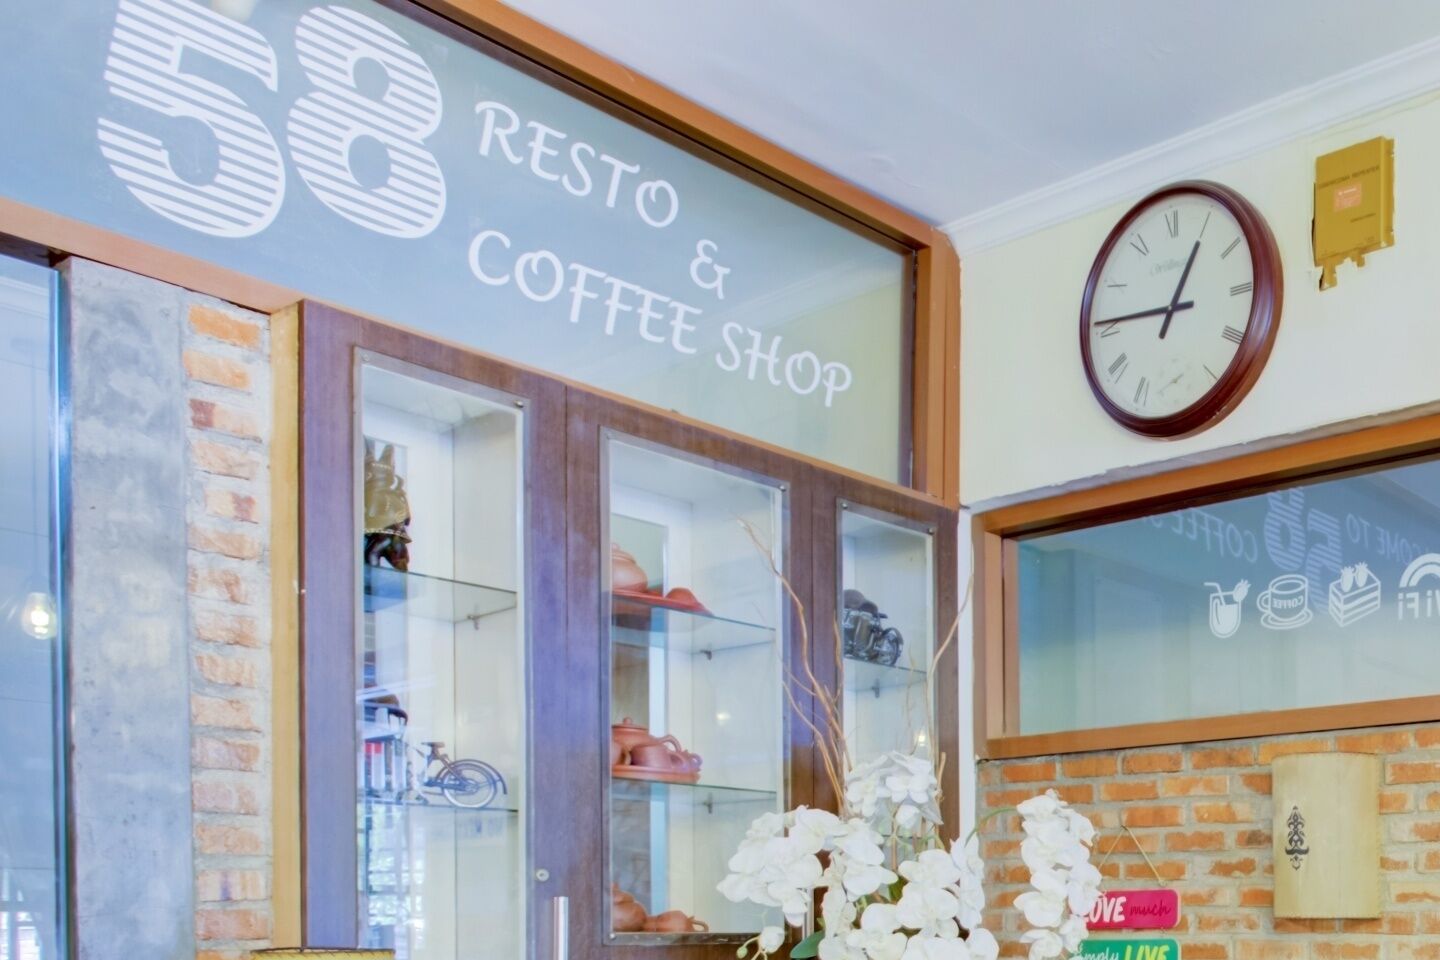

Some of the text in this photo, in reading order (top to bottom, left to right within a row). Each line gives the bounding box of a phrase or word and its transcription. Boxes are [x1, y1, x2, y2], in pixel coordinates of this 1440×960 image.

[97, 0, 447, 239] 58
[475, 100, 679, 228] RESTO
[468, 230, 852, 407] COFFEE SHOP
[690, 239, 731, 299] &
[1084, 896, 1172, 923] OVE much
